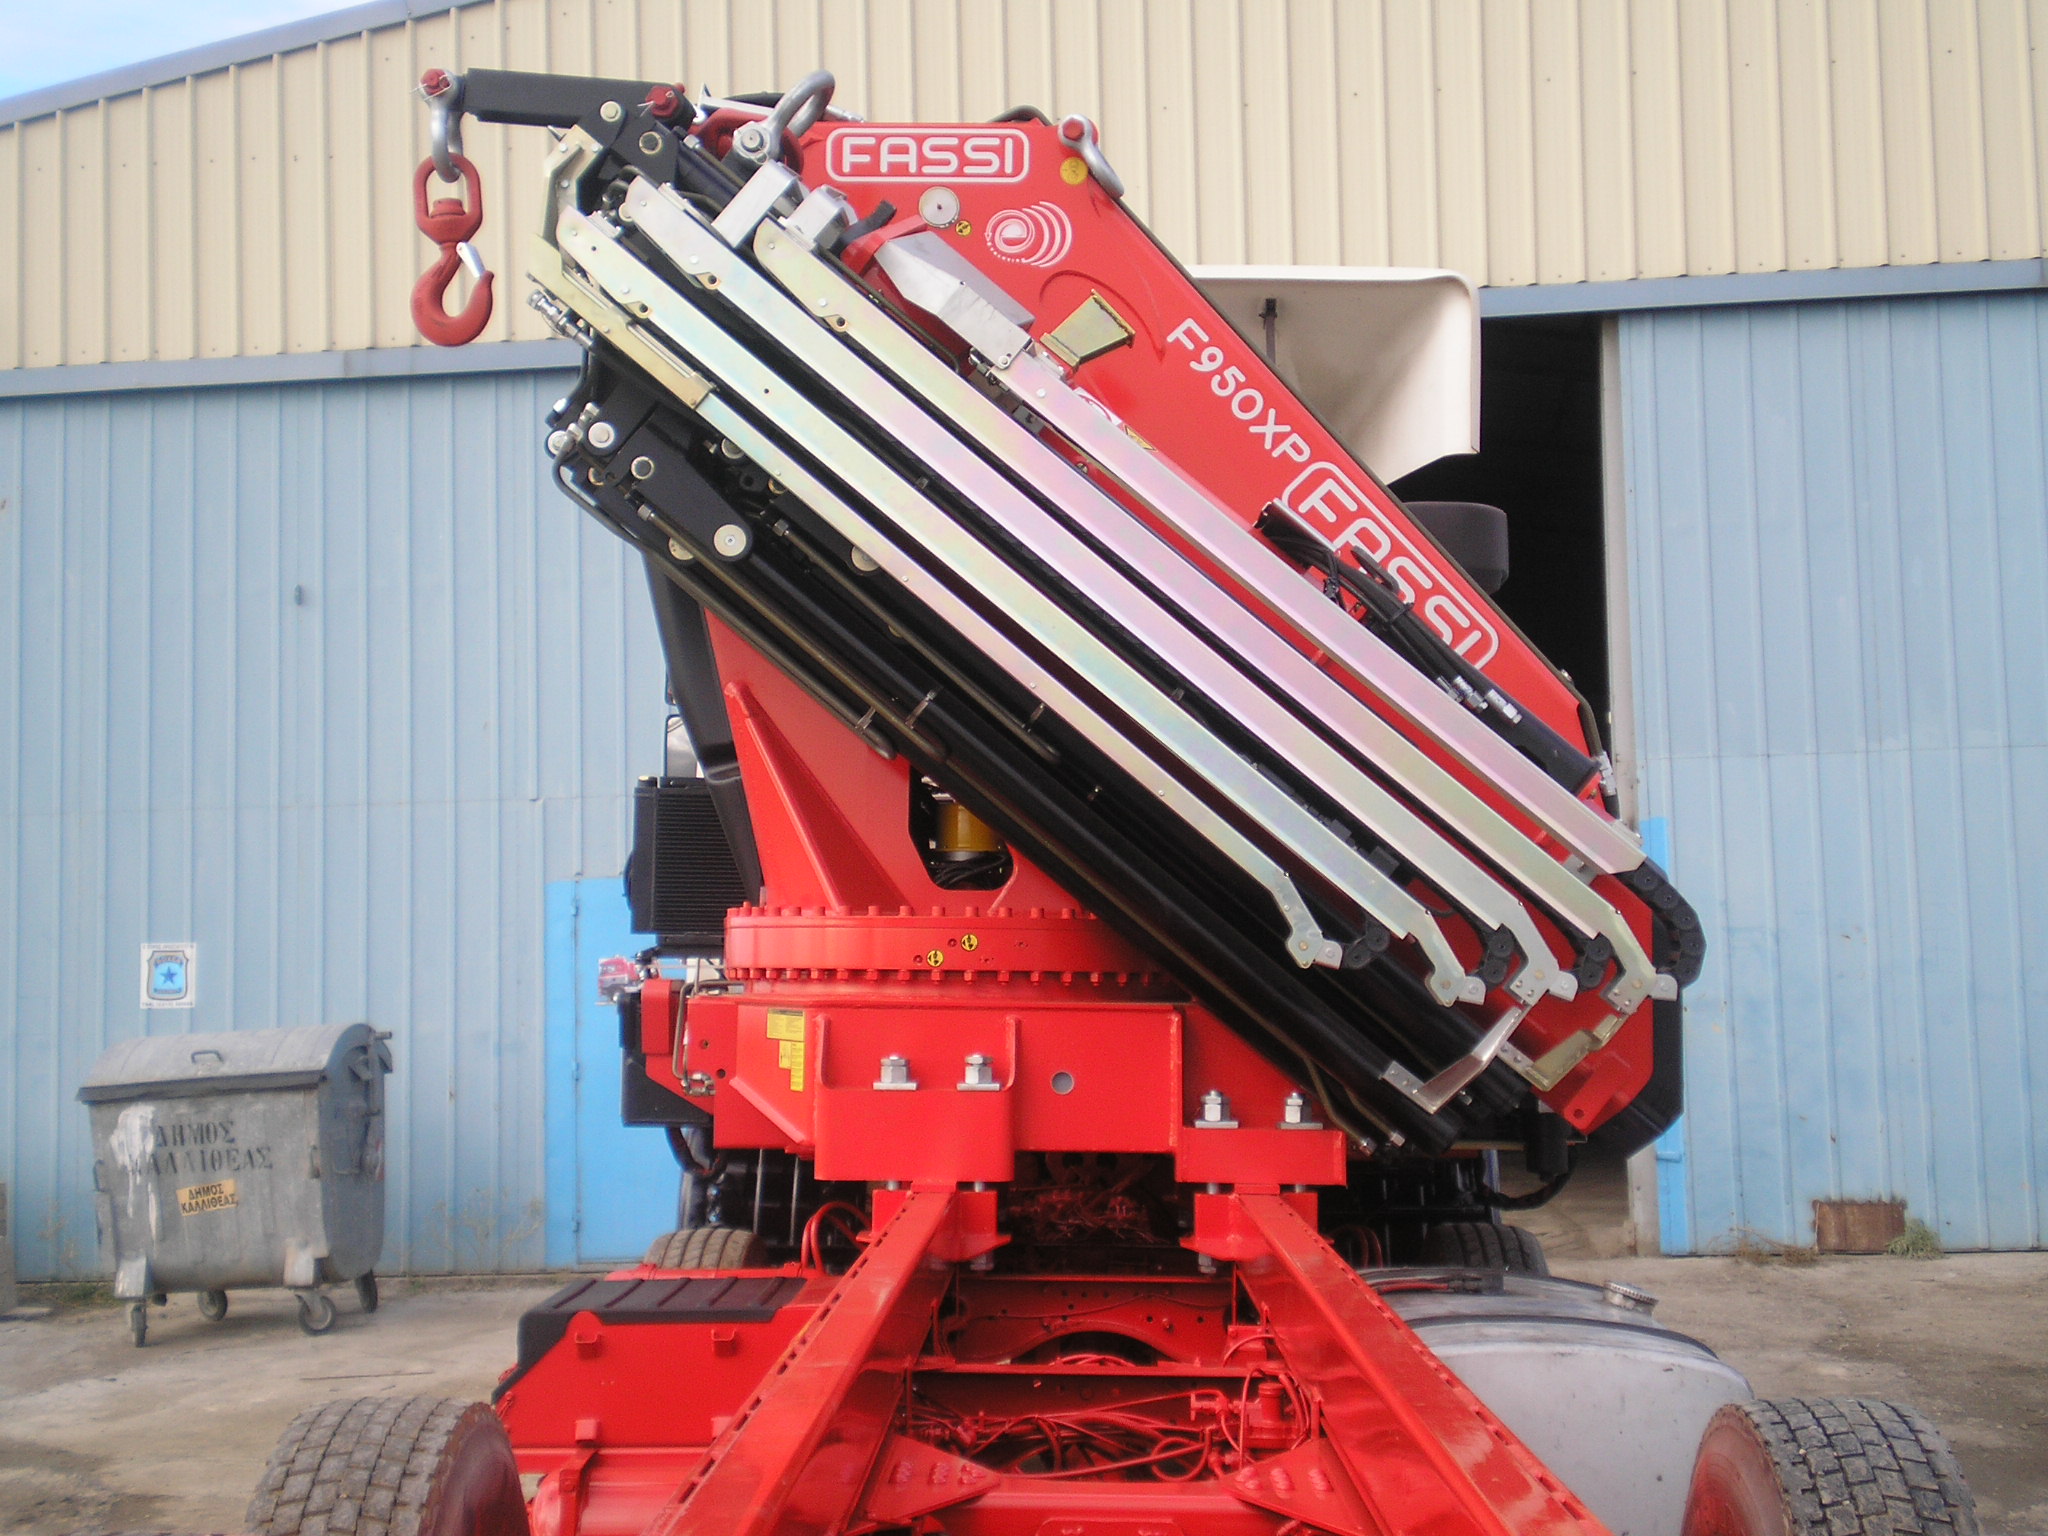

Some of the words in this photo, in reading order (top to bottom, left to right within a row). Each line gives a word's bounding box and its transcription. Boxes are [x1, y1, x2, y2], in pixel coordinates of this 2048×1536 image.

[842, 137, 1013, 174] FASSI
[1166, 317, 1311, 463] F950XP
[156, 1121, 236, 1147] ΔΗΜΟΣ
[132, 1146, 274, 1177] ΑΛΛΙΘΕΑΣ
[188, 1183, 224, 1200] ΔΗΜΟΣ
